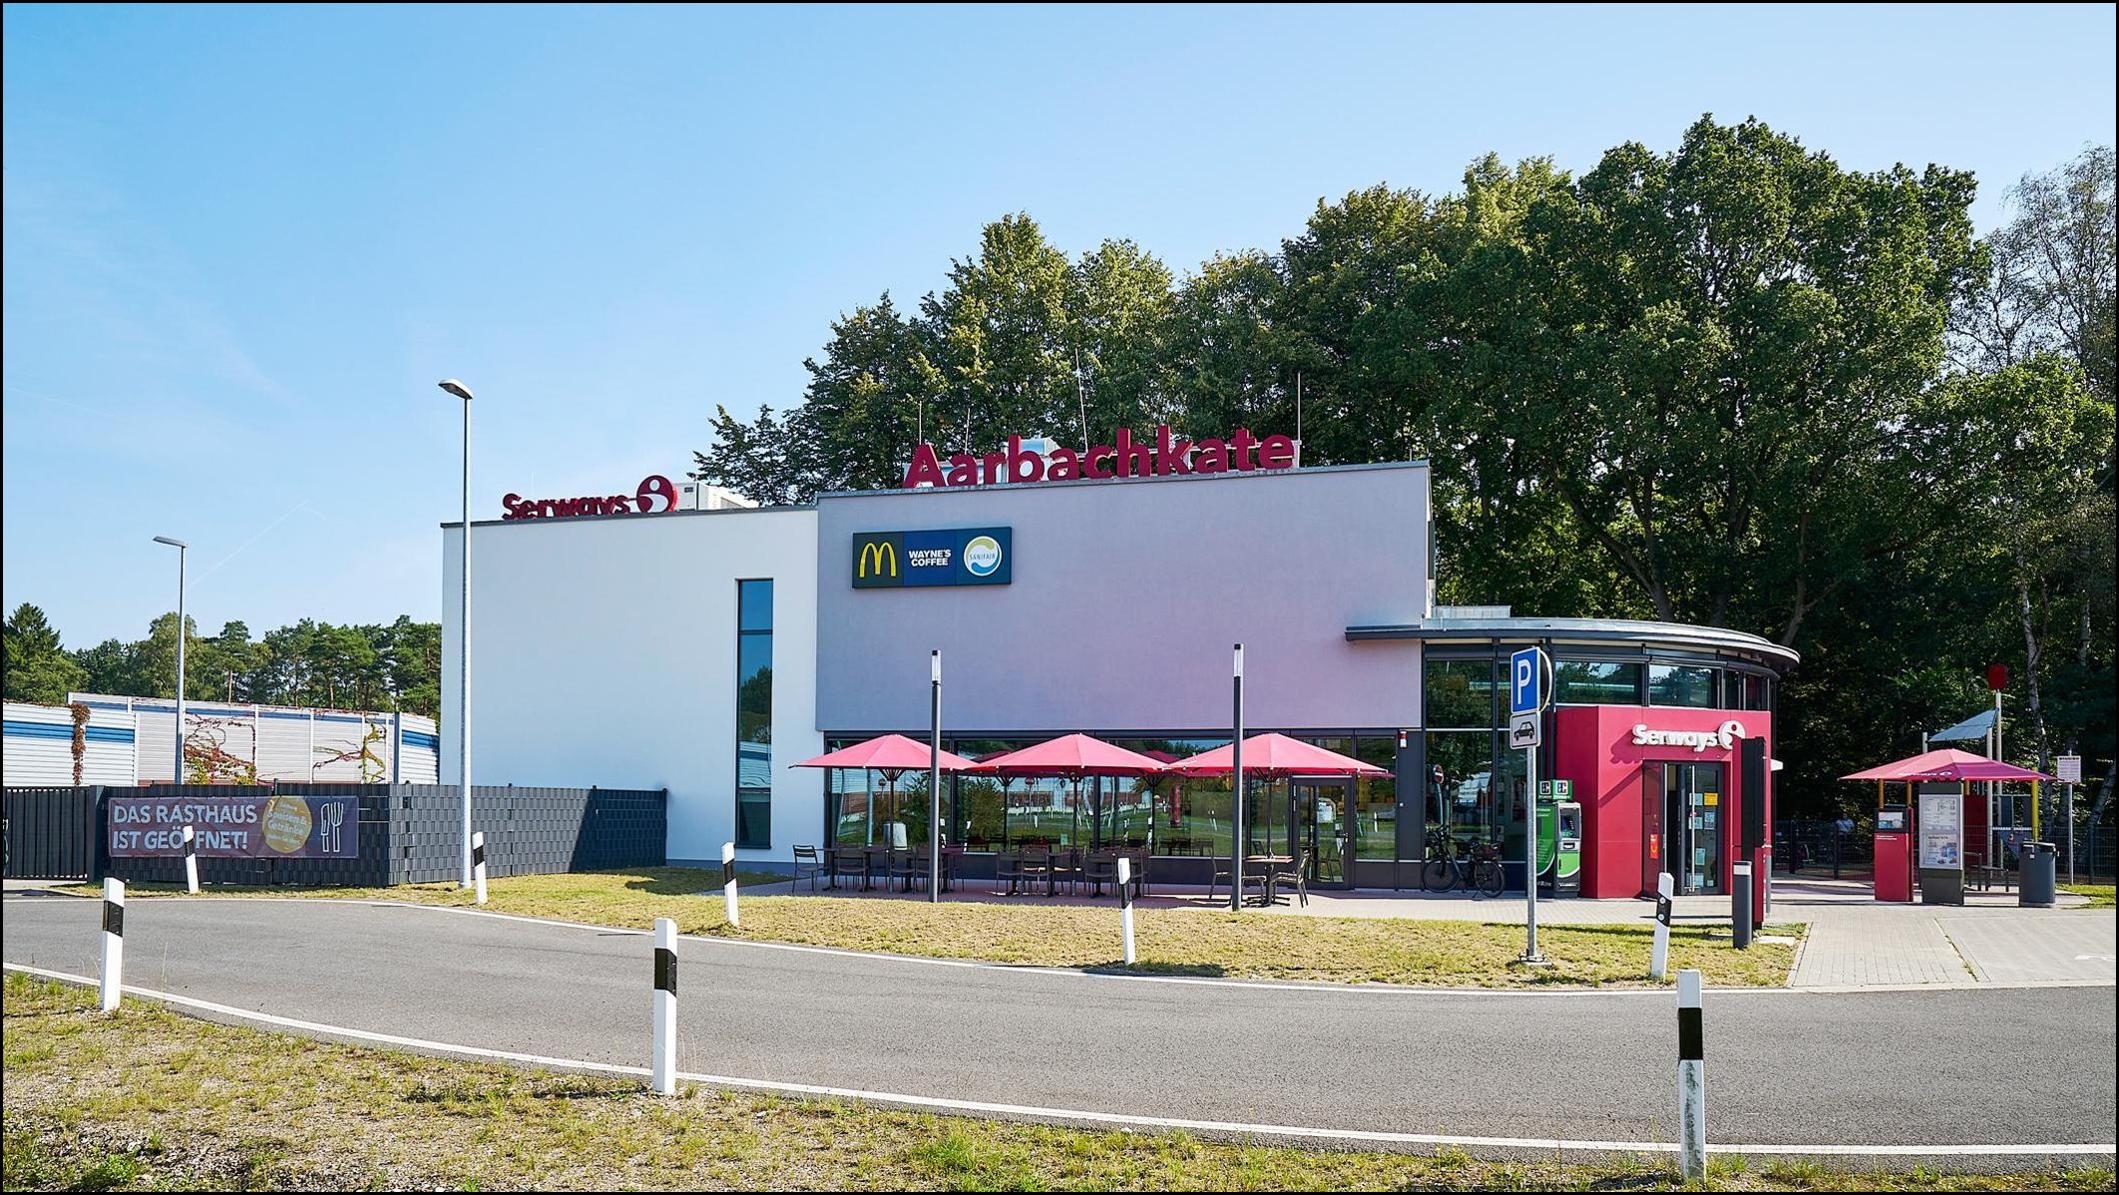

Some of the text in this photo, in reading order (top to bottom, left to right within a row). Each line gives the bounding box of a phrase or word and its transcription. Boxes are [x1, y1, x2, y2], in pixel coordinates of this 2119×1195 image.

[902, 425, 1295, 487] Aarbachkate
[502, 493, 631, 520] Serways
[908, 549, 952, 560] WAYNE'S
[911, 557, 949, 567] COFFEE
[1517, 659, 1532, 704] P
[1632, 724, 1719, 752] Serways
[113, 805, 151, 823] DAS
[156, 804, 258, 824] RASTHAUS
[112, 831, 142, 849] IST
[144, 825, 248, 850] GEÖFNET!
